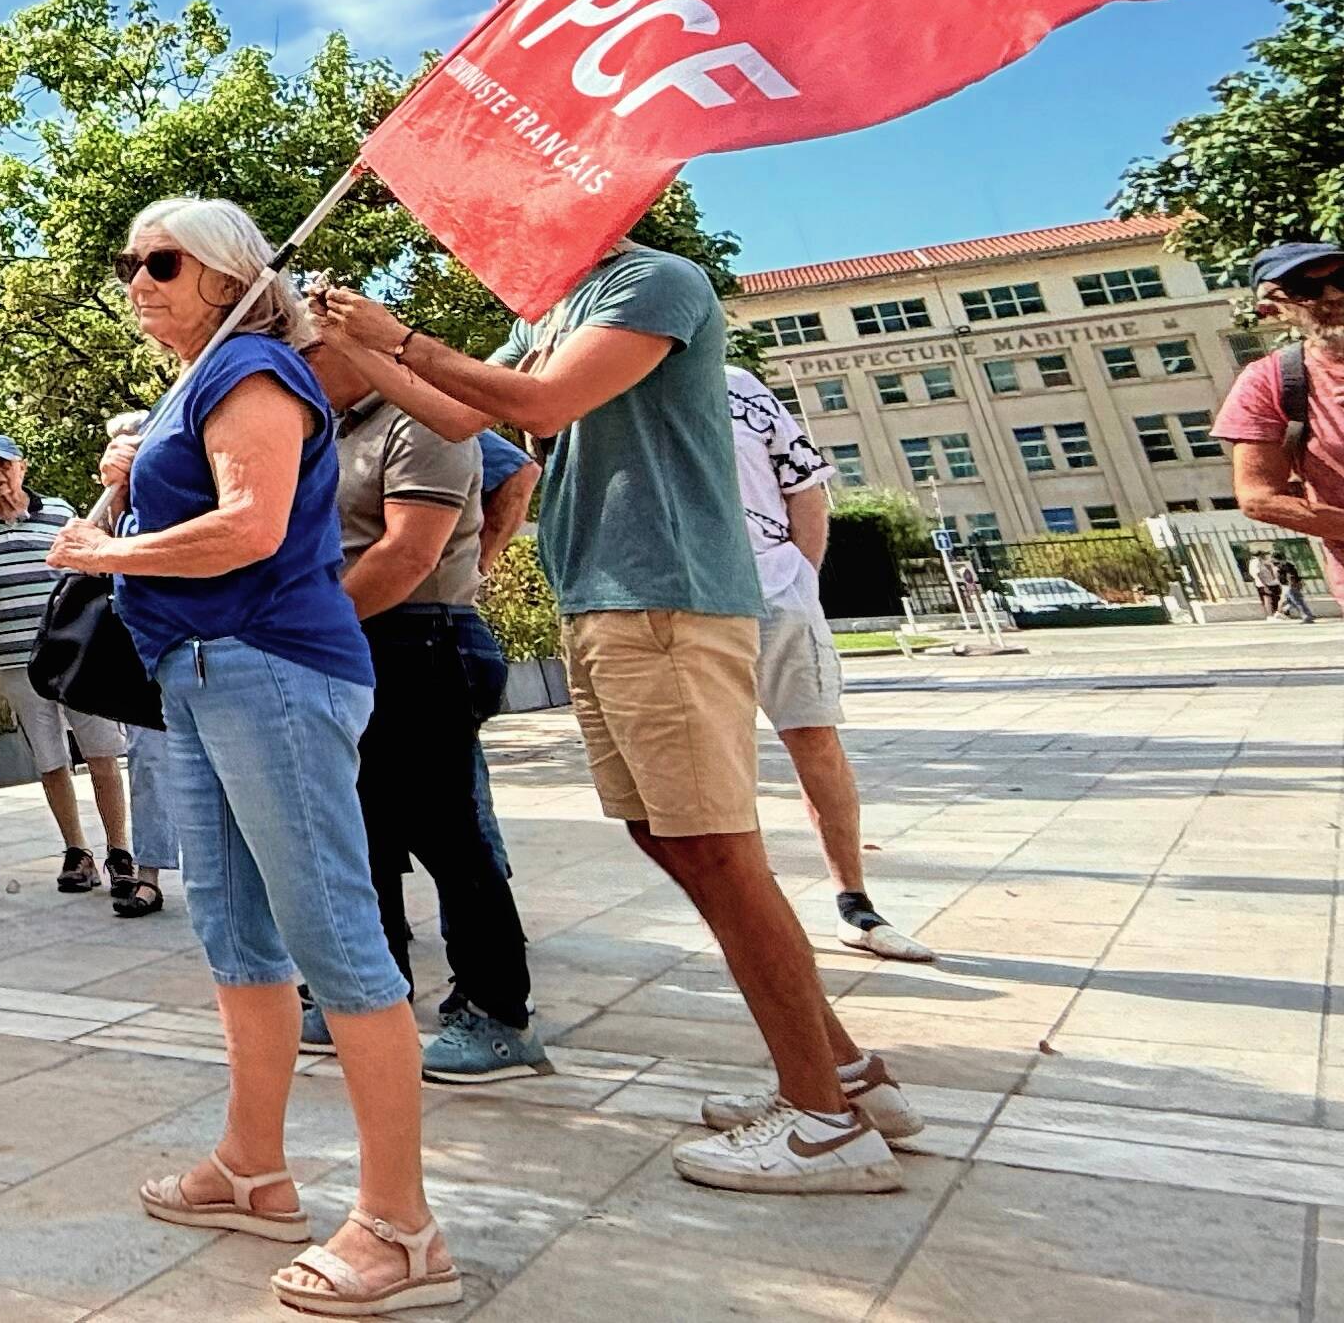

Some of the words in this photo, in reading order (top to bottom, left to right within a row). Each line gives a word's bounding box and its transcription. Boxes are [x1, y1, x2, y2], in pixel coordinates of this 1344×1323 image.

[504, 105, 612, 194] FRANÇAIS
[801, 341, 978, 375] PREFECTURE
[993, 321, 1139, 353] MARITIME
